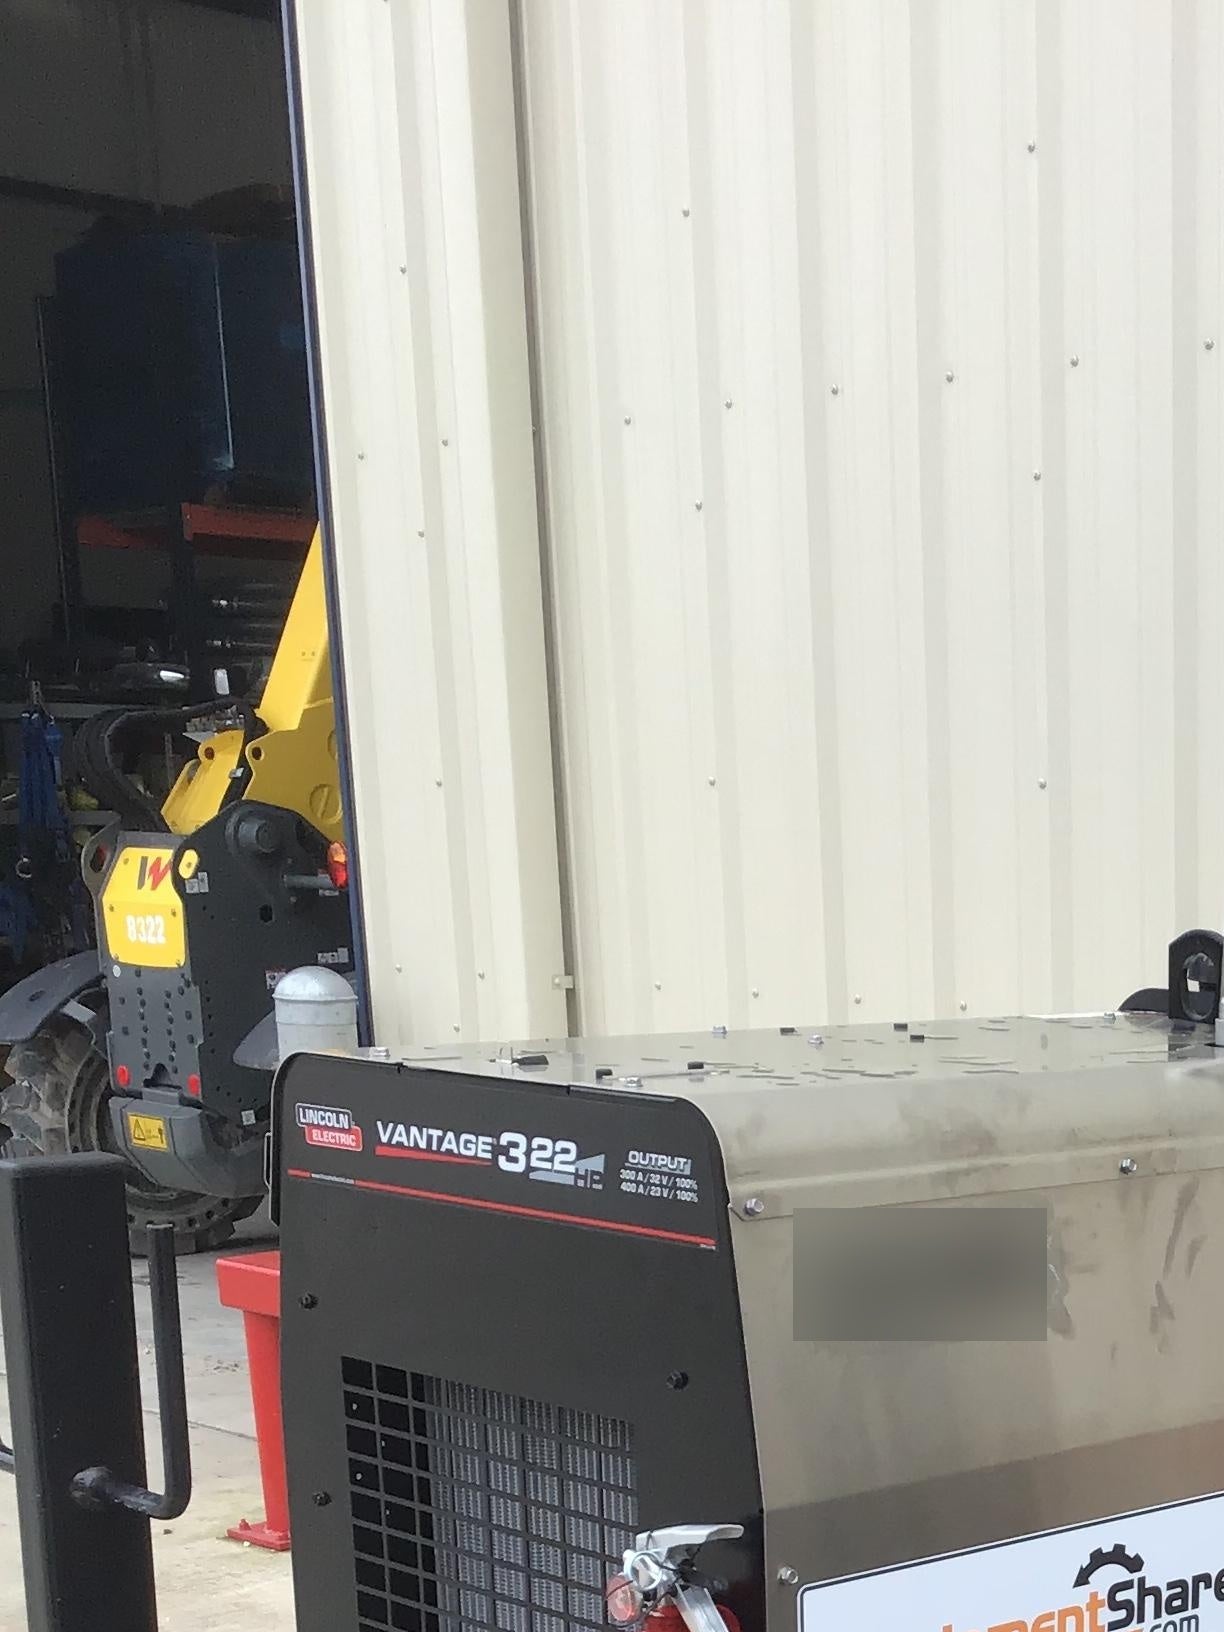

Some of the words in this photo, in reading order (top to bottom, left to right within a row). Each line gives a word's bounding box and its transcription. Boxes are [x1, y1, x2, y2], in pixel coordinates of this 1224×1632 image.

[125, 913, 166, 945] 8322
[299, 1107, 350, 1130] LINCOLN
[311, 1128, 357, 1146] ELECTRIC
[376, 1119, 493, 1159] VANTAGE
[496, 1130, 577, 1173] 322
[628, 1150, 687, 1169] OUTPUT
